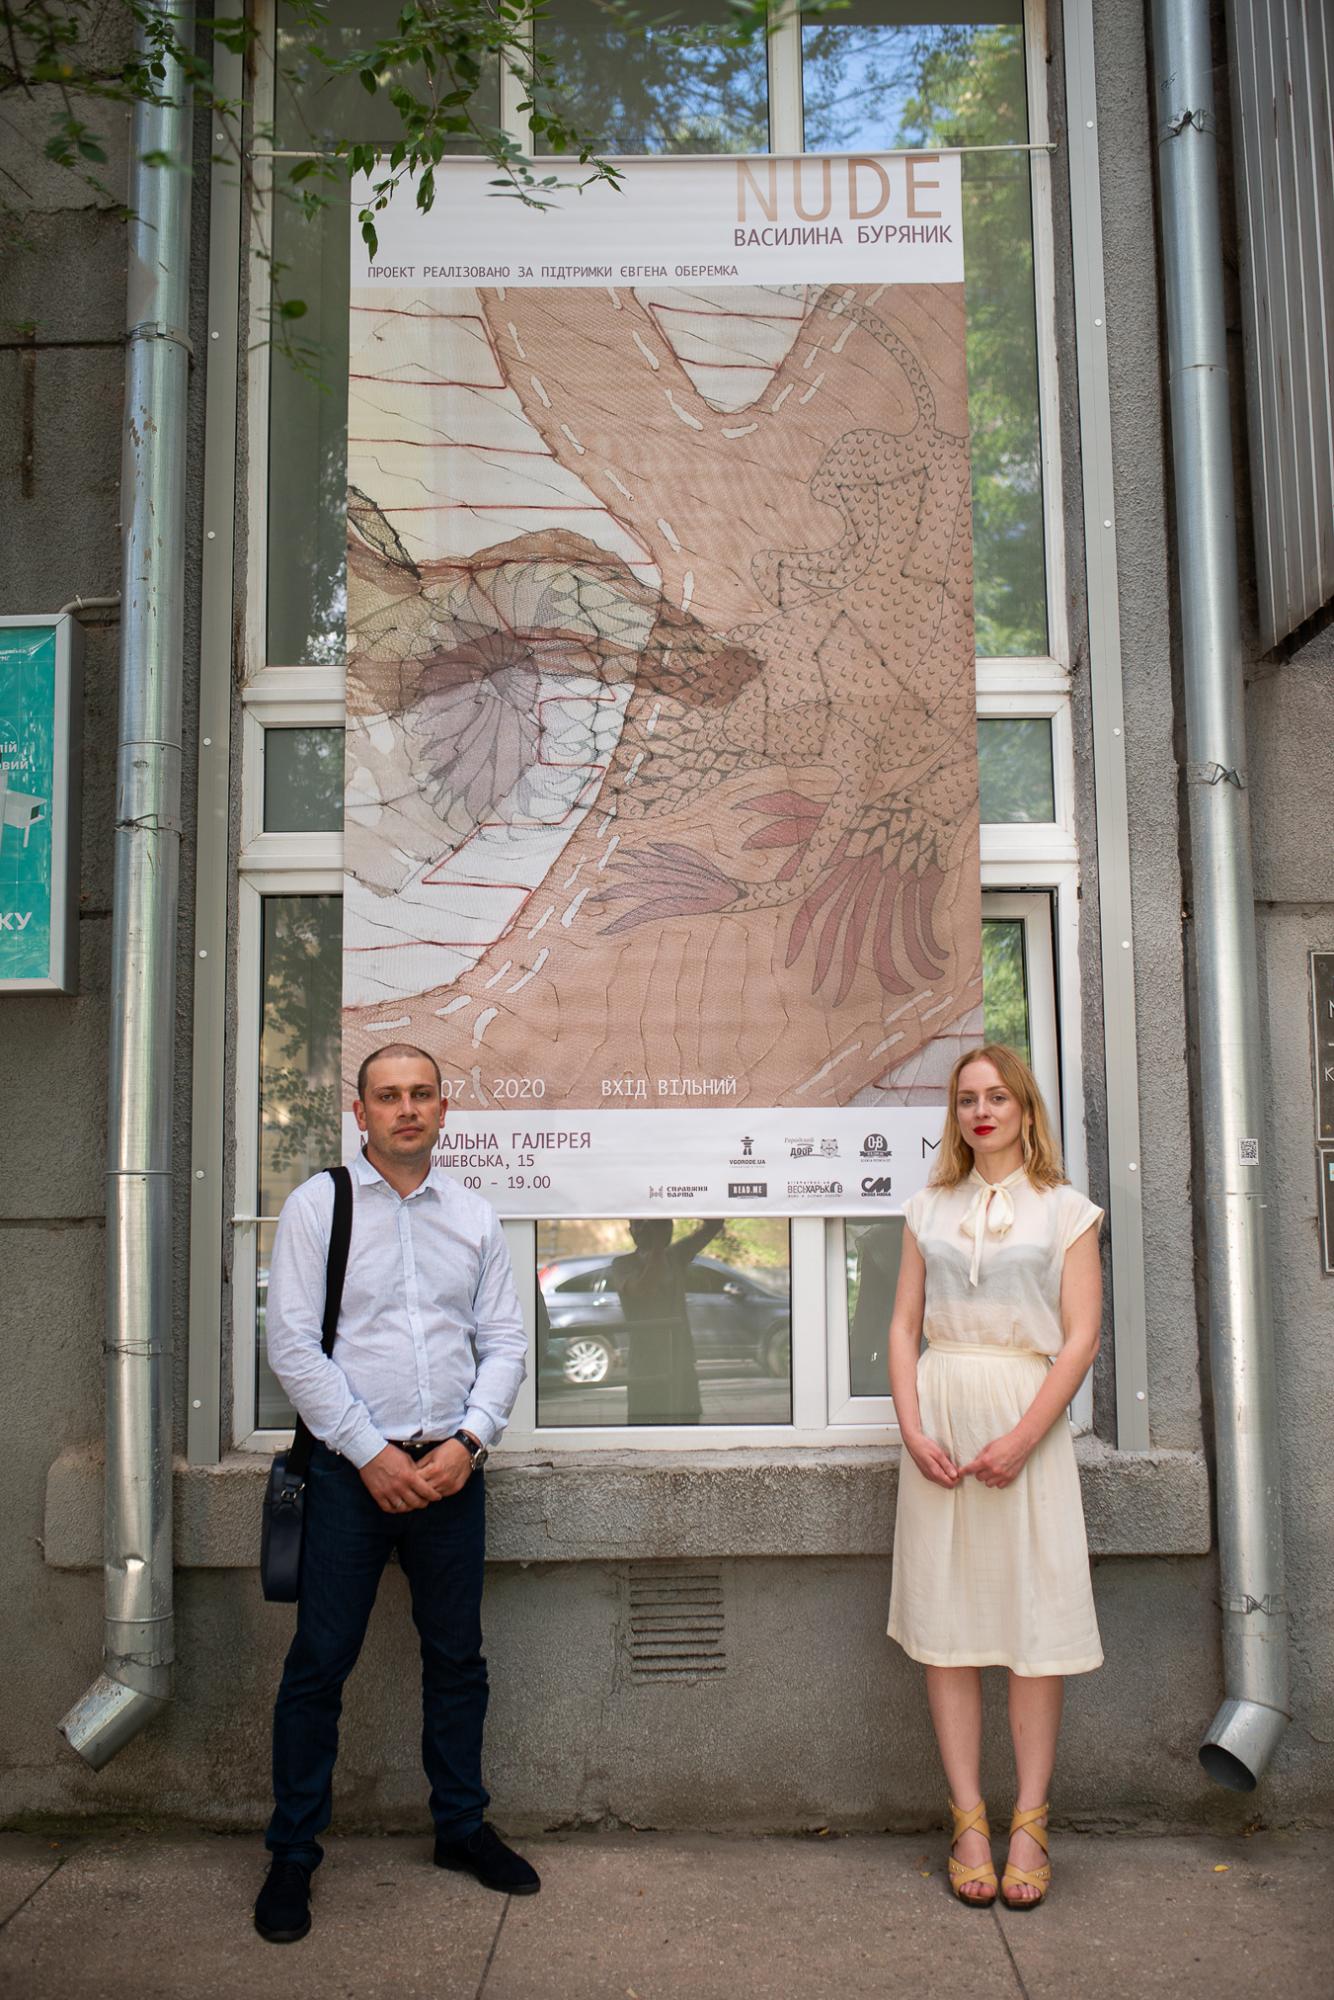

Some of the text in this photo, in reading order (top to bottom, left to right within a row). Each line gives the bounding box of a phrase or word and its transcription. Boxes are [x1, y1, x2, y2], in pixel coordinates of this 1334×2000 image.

[735, 155, 942, 223] NUDE
[734, 224, 953, 247] ВАСИЛИНА БУРЯНИК
[367, 265, 739, 280] ПРОЕКТ РЕАЛІЗОВАНО ЗА ПІДТРИМКИ ЄВГЕНА ОБЕРЕМКА
[493, 1078, 546, 1098] 2020
[601, 1075, 738, 1100] ВХІД ВІЛЬНИЙ
[511, 1132, 592, 1149] ГАЛЕРЕЯ
[518, 1154, 535, 1167] 15
[507, 1175, 551, 1189] 19.00
